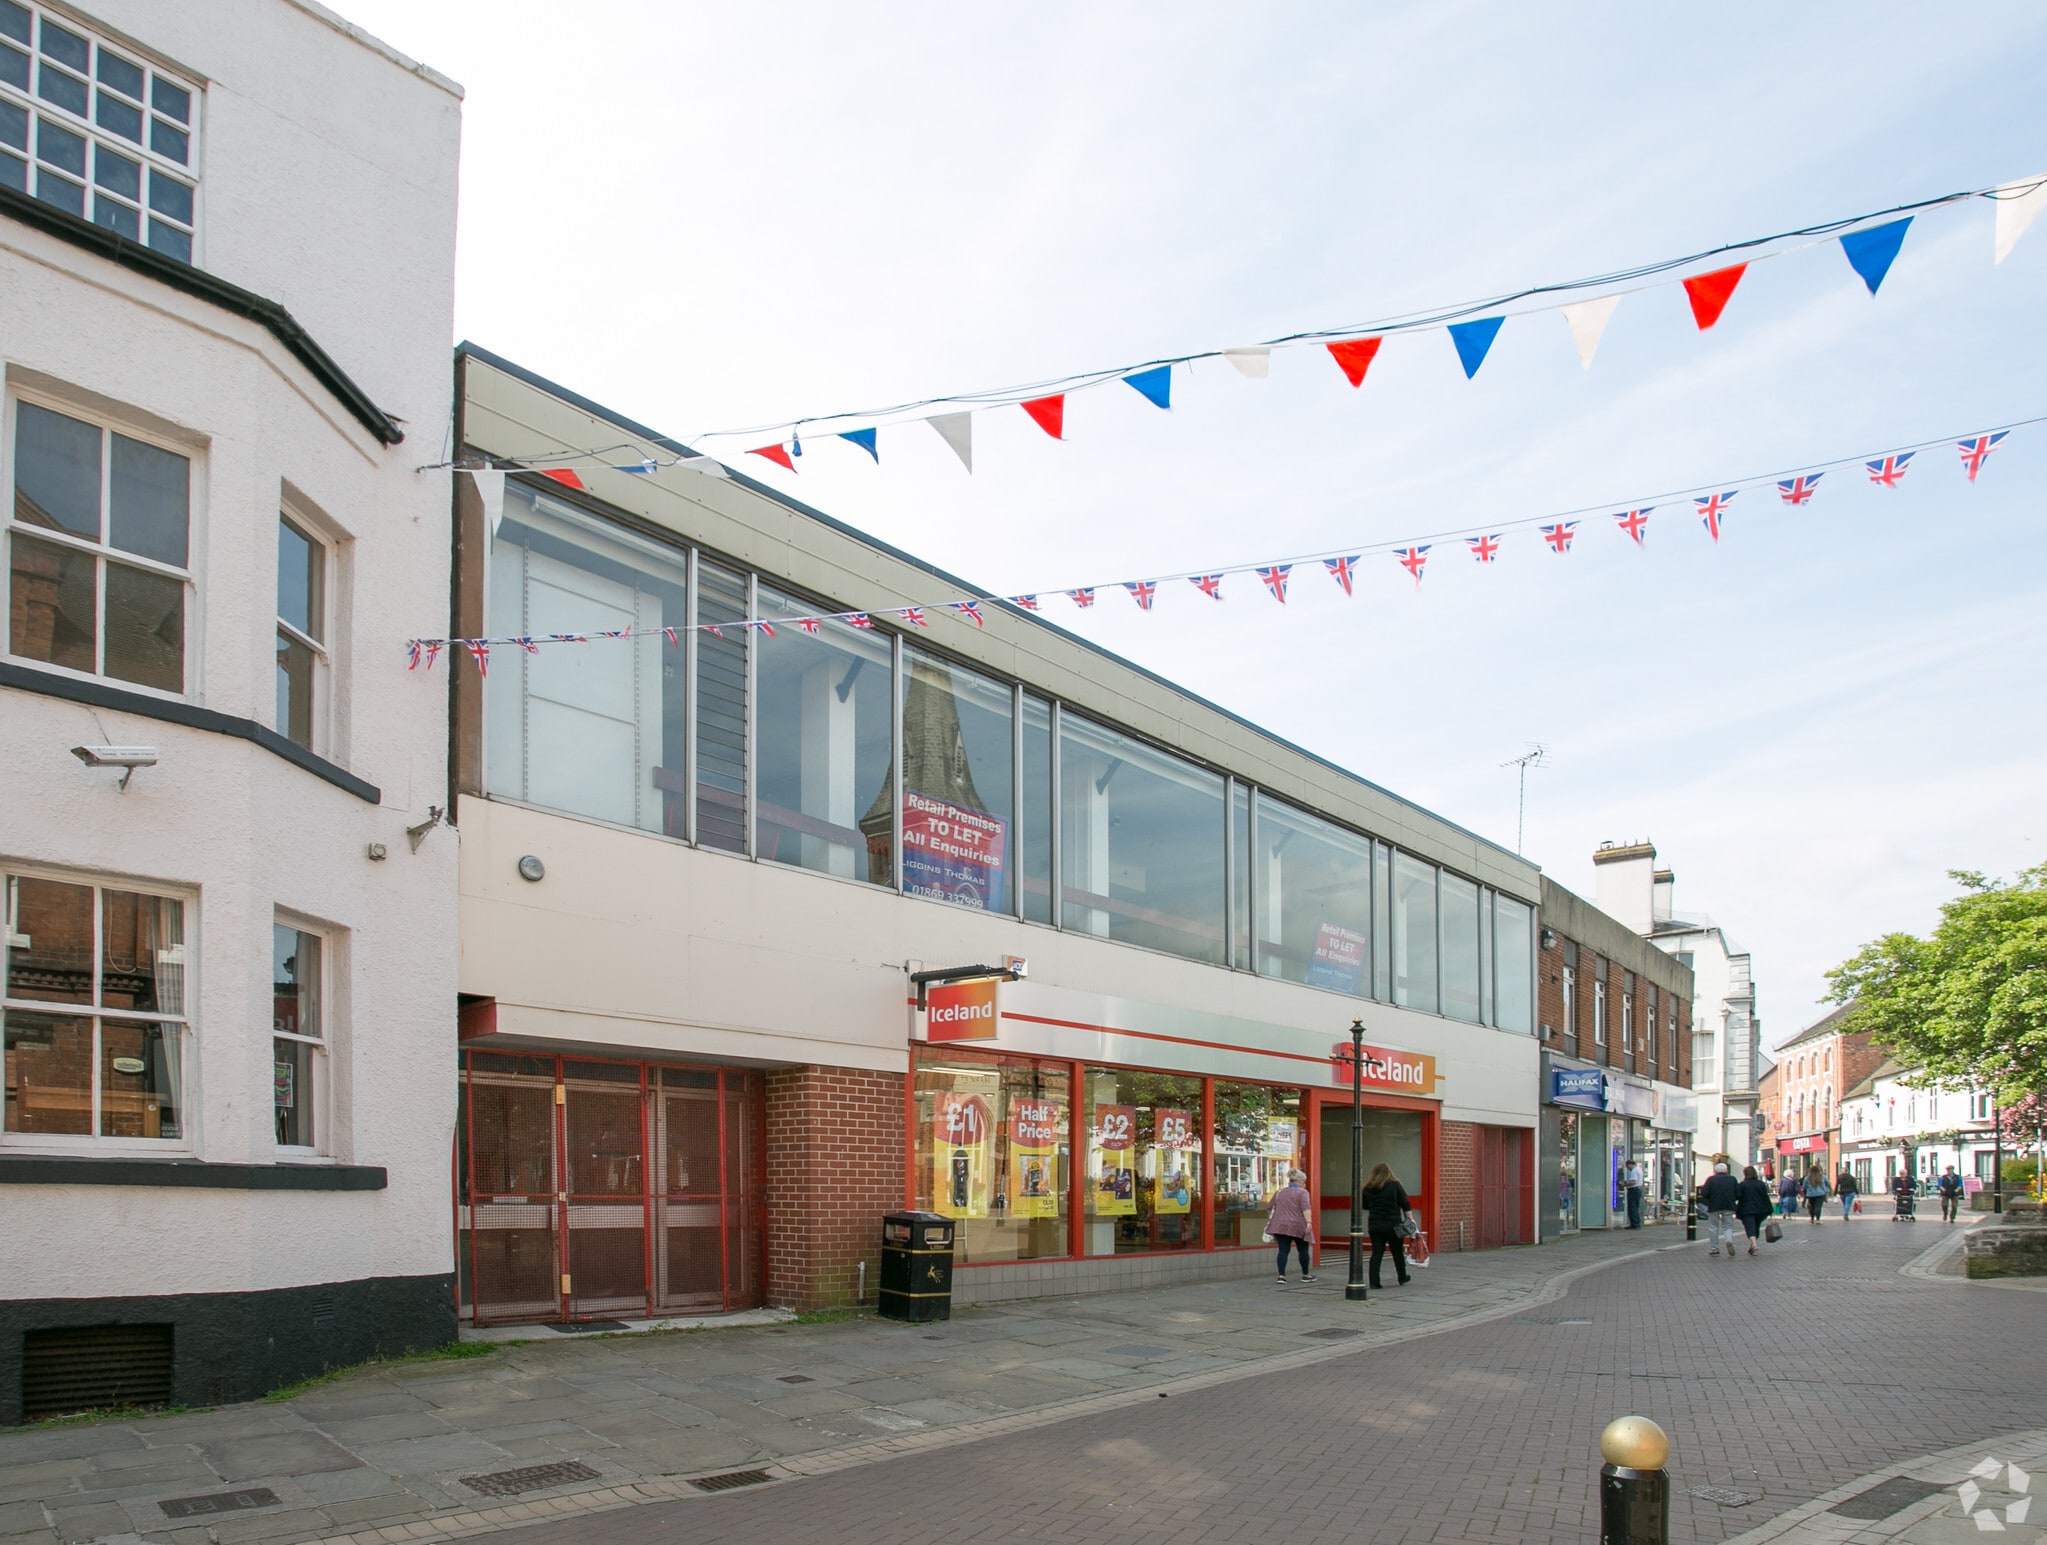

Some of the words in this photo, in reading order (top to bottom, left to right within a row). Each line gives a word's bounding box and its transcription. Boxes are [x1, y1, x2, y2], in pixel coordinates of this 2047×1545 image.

[909, 793, 945, 816] Retail
[948, 806, 1002, 834] Premises
[928, 817, 949, 836] TO
[954, 825, 982, 845] LET
[903, 830, 925, 846] All
[930, 836, 1000, 866] Enquiries
[944, 868, 985, 886] THOMAS
[912, 884, 944, 900] 01869
[1321, 922, 1340, 936] Retail
[1340, 928, 1366, 944] Premises
[1315, 947, 1328, 957] All
[1328, 950, 1360, 966] Enquiries
[1329, 938, 1340, 949] TO
[1340, 941, 1356, 953] LET
[931, 1001, 992, 1023] Iceland
[1361, 1052, 1423, 1085] Iceland
[1560, 1078, 1599, 1087] HALIFAX
[946, 1102, 976, 1132] £1
[1021, 1104, 1049, 1122] Half
[1018, 1122, 1051, 1139] Price
[1103, 1113, 1129, 1140] £2
[1162, 1117, 1186, 1141] £5
